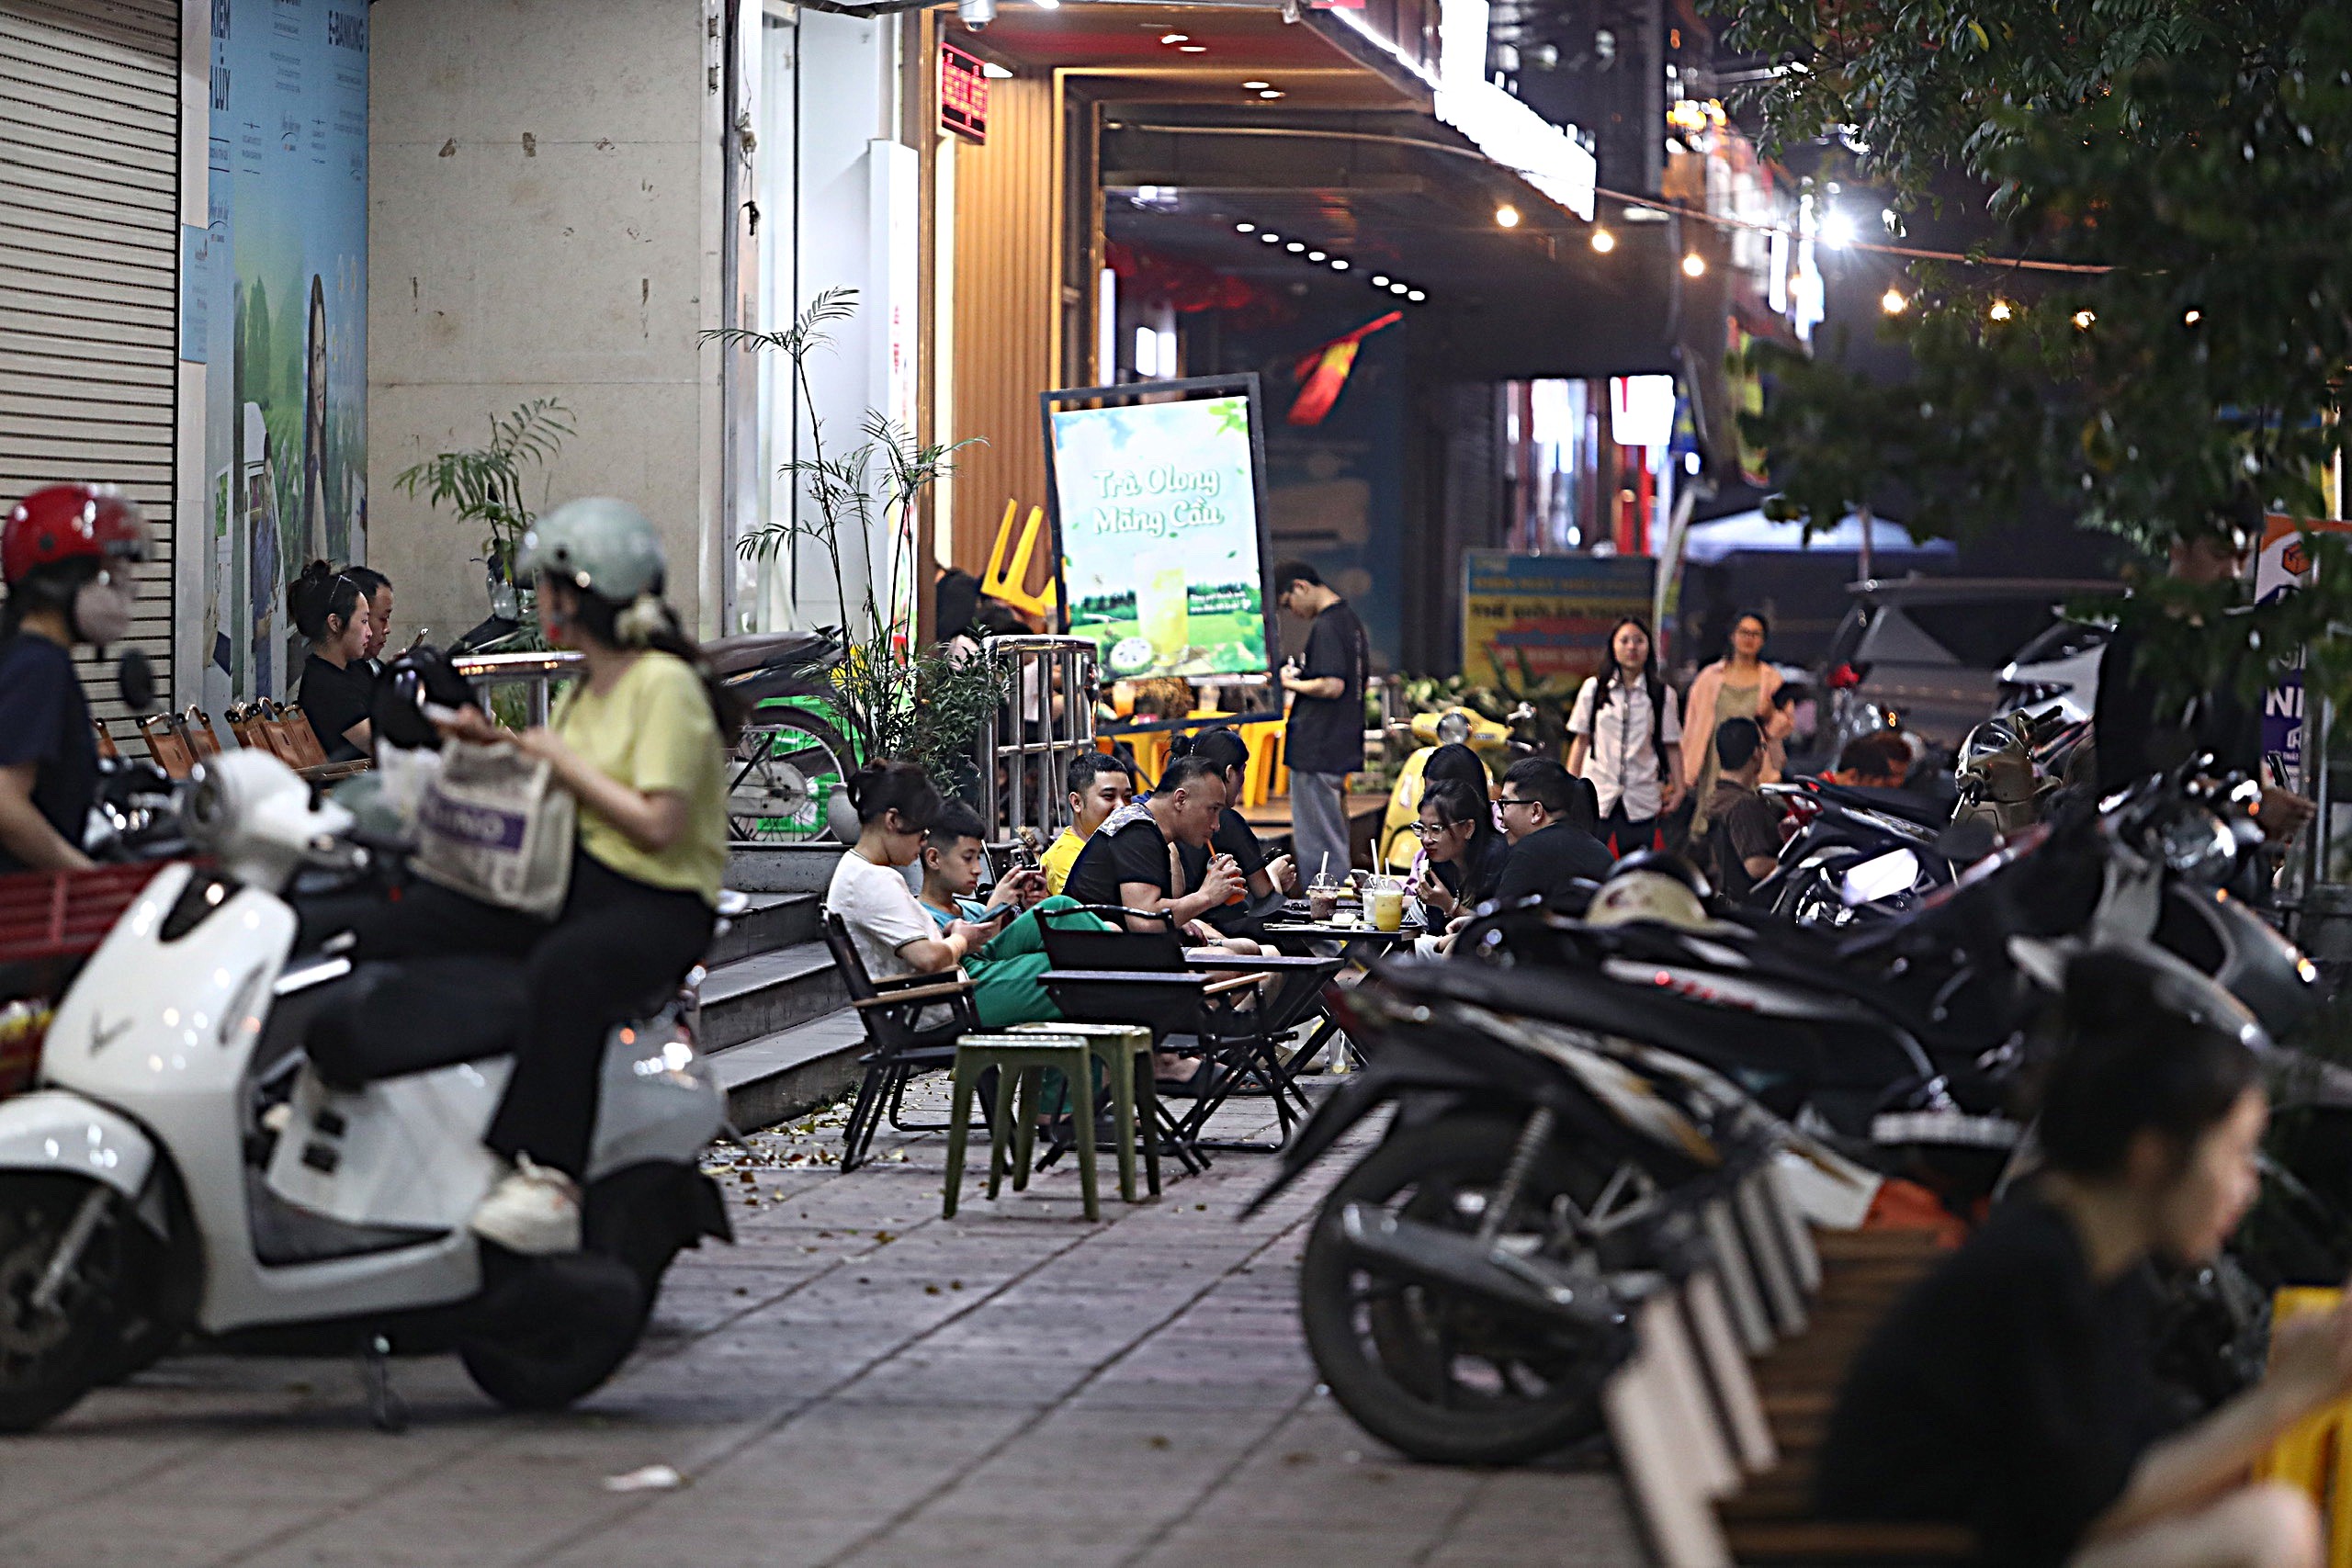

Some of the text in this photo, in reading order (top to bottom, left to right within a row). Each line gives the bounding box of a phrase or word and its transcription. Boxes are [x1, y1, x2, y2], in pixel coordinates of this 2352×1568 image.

[329, 10, 364, 52] E-BANKING
[1094, 465, 1220, 498] Trà Olong
